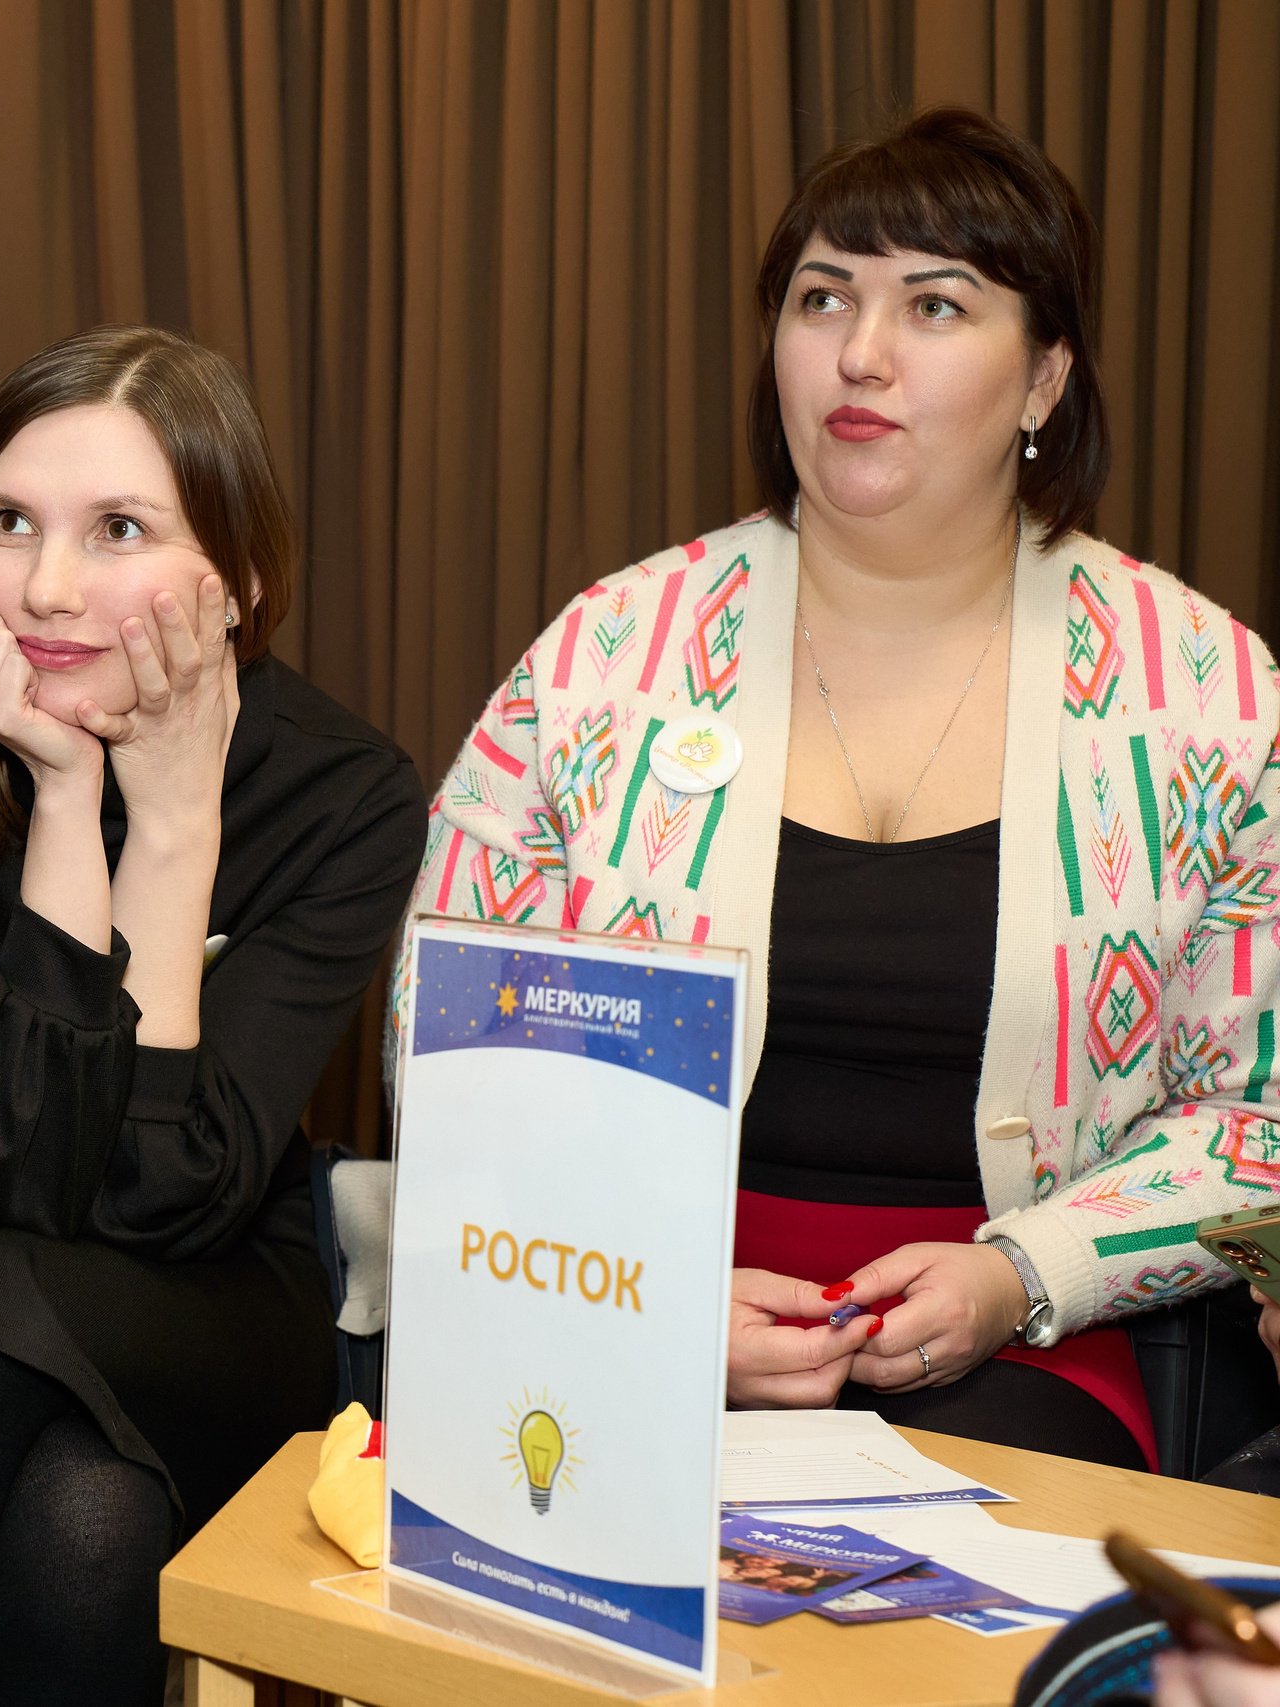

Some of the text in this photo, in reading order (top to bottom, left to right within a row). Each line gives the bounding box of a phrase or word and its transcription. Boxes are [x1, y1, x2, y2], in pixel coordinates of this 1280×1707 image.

[524, 985, 641, 1025] МЕРКУРИЯ
[461, 1223, 643, 1313] РОСТОК
[778, 1538, 901, 1563] МЕРКУРИЯ
[451, 1550, 631, 1623] Сила помогать есть в каждом!
